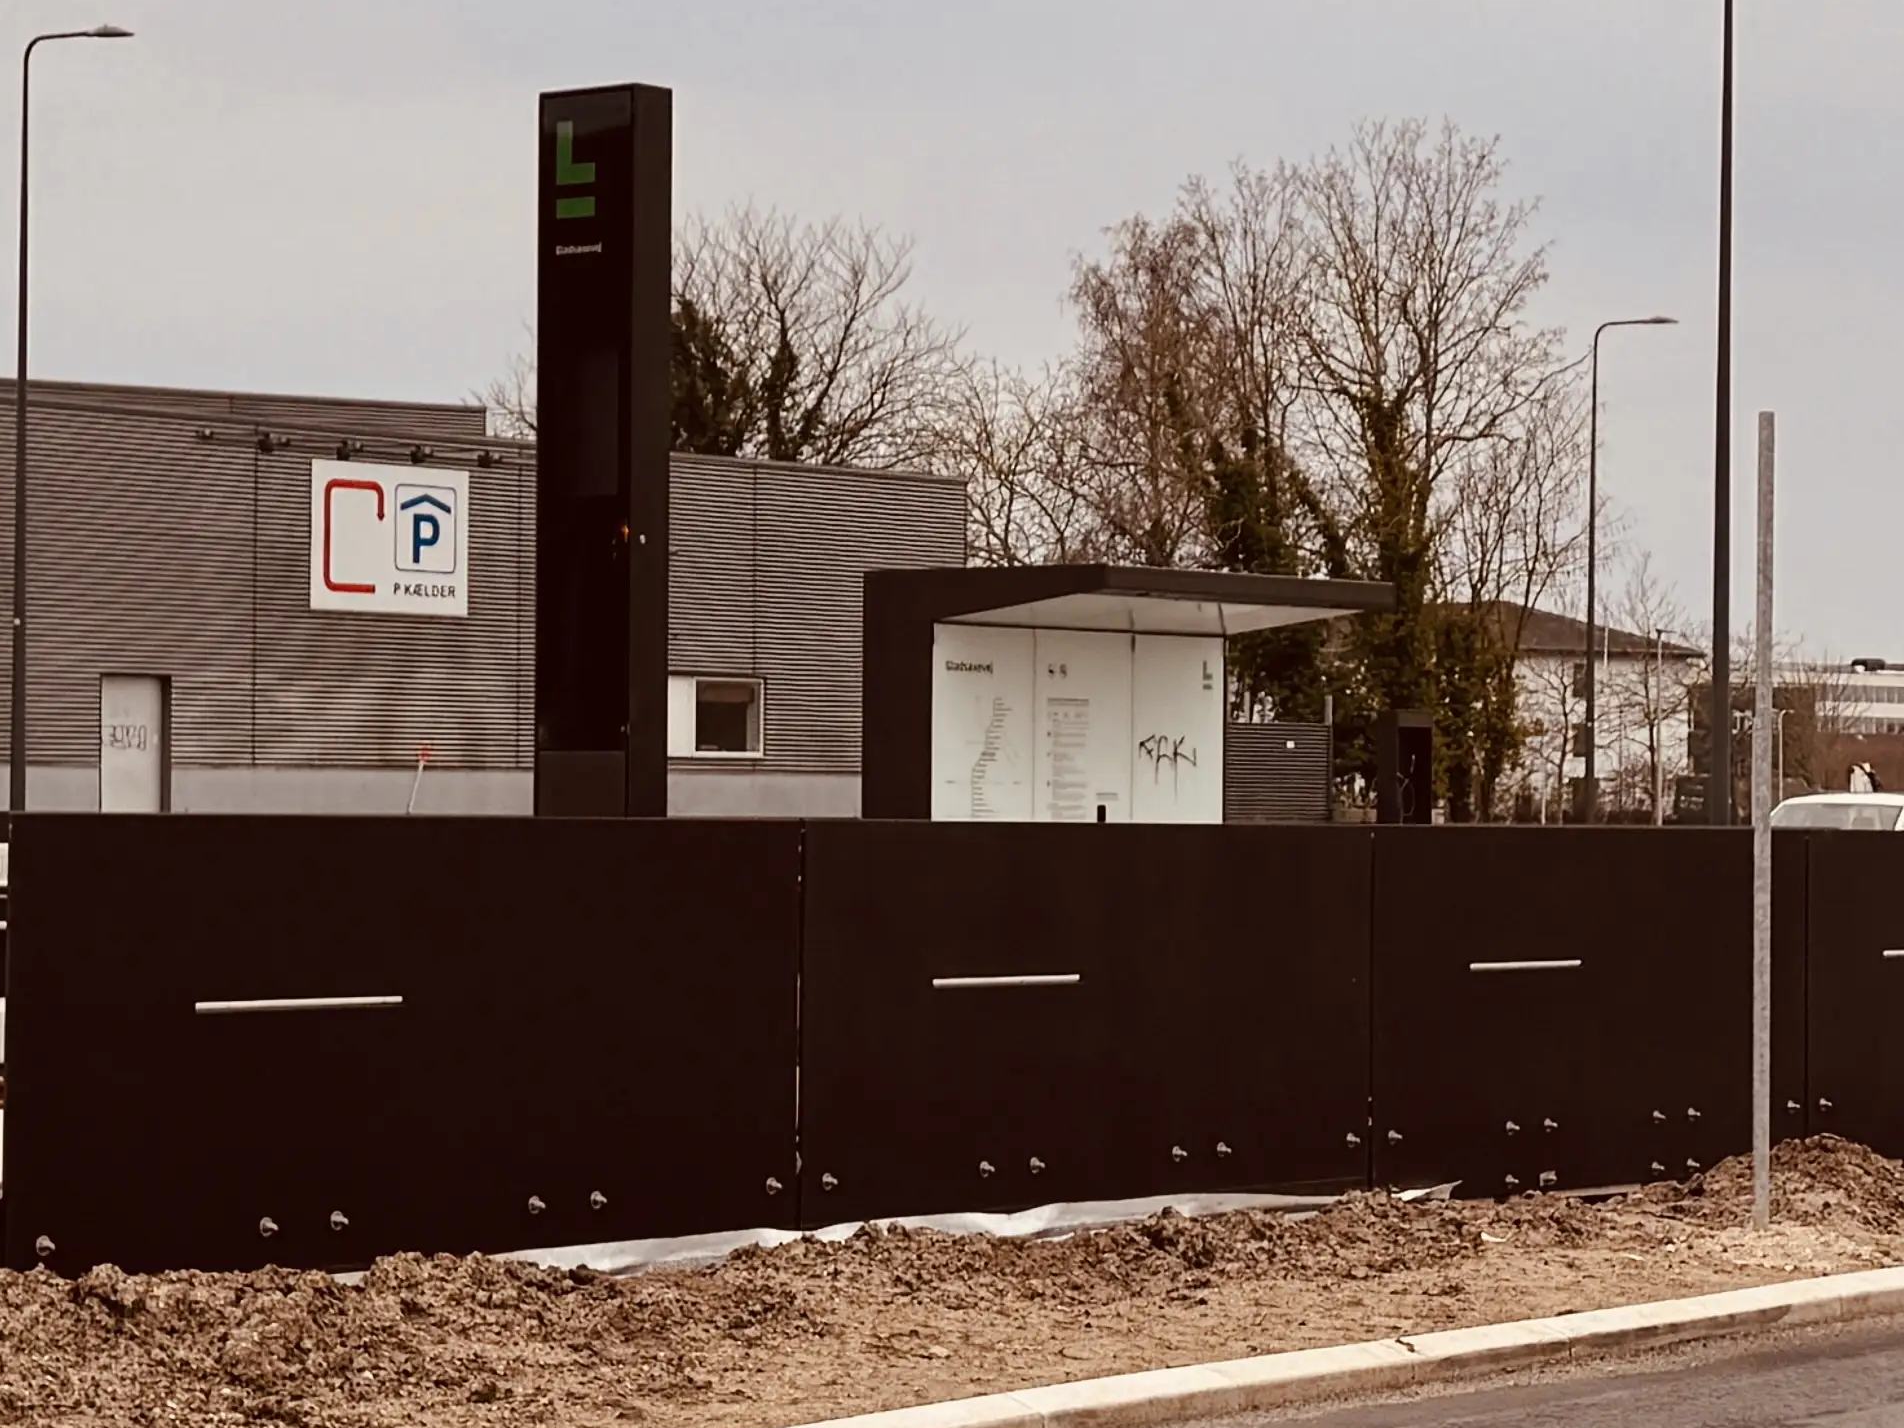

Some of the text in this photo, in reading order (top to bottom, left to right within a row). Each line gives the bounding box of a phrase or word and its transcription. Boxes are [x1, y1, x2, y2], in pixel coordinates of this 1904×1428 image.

[412, 513, 440, 564] P
[393, 582, 455, 598] P KÆLDER
